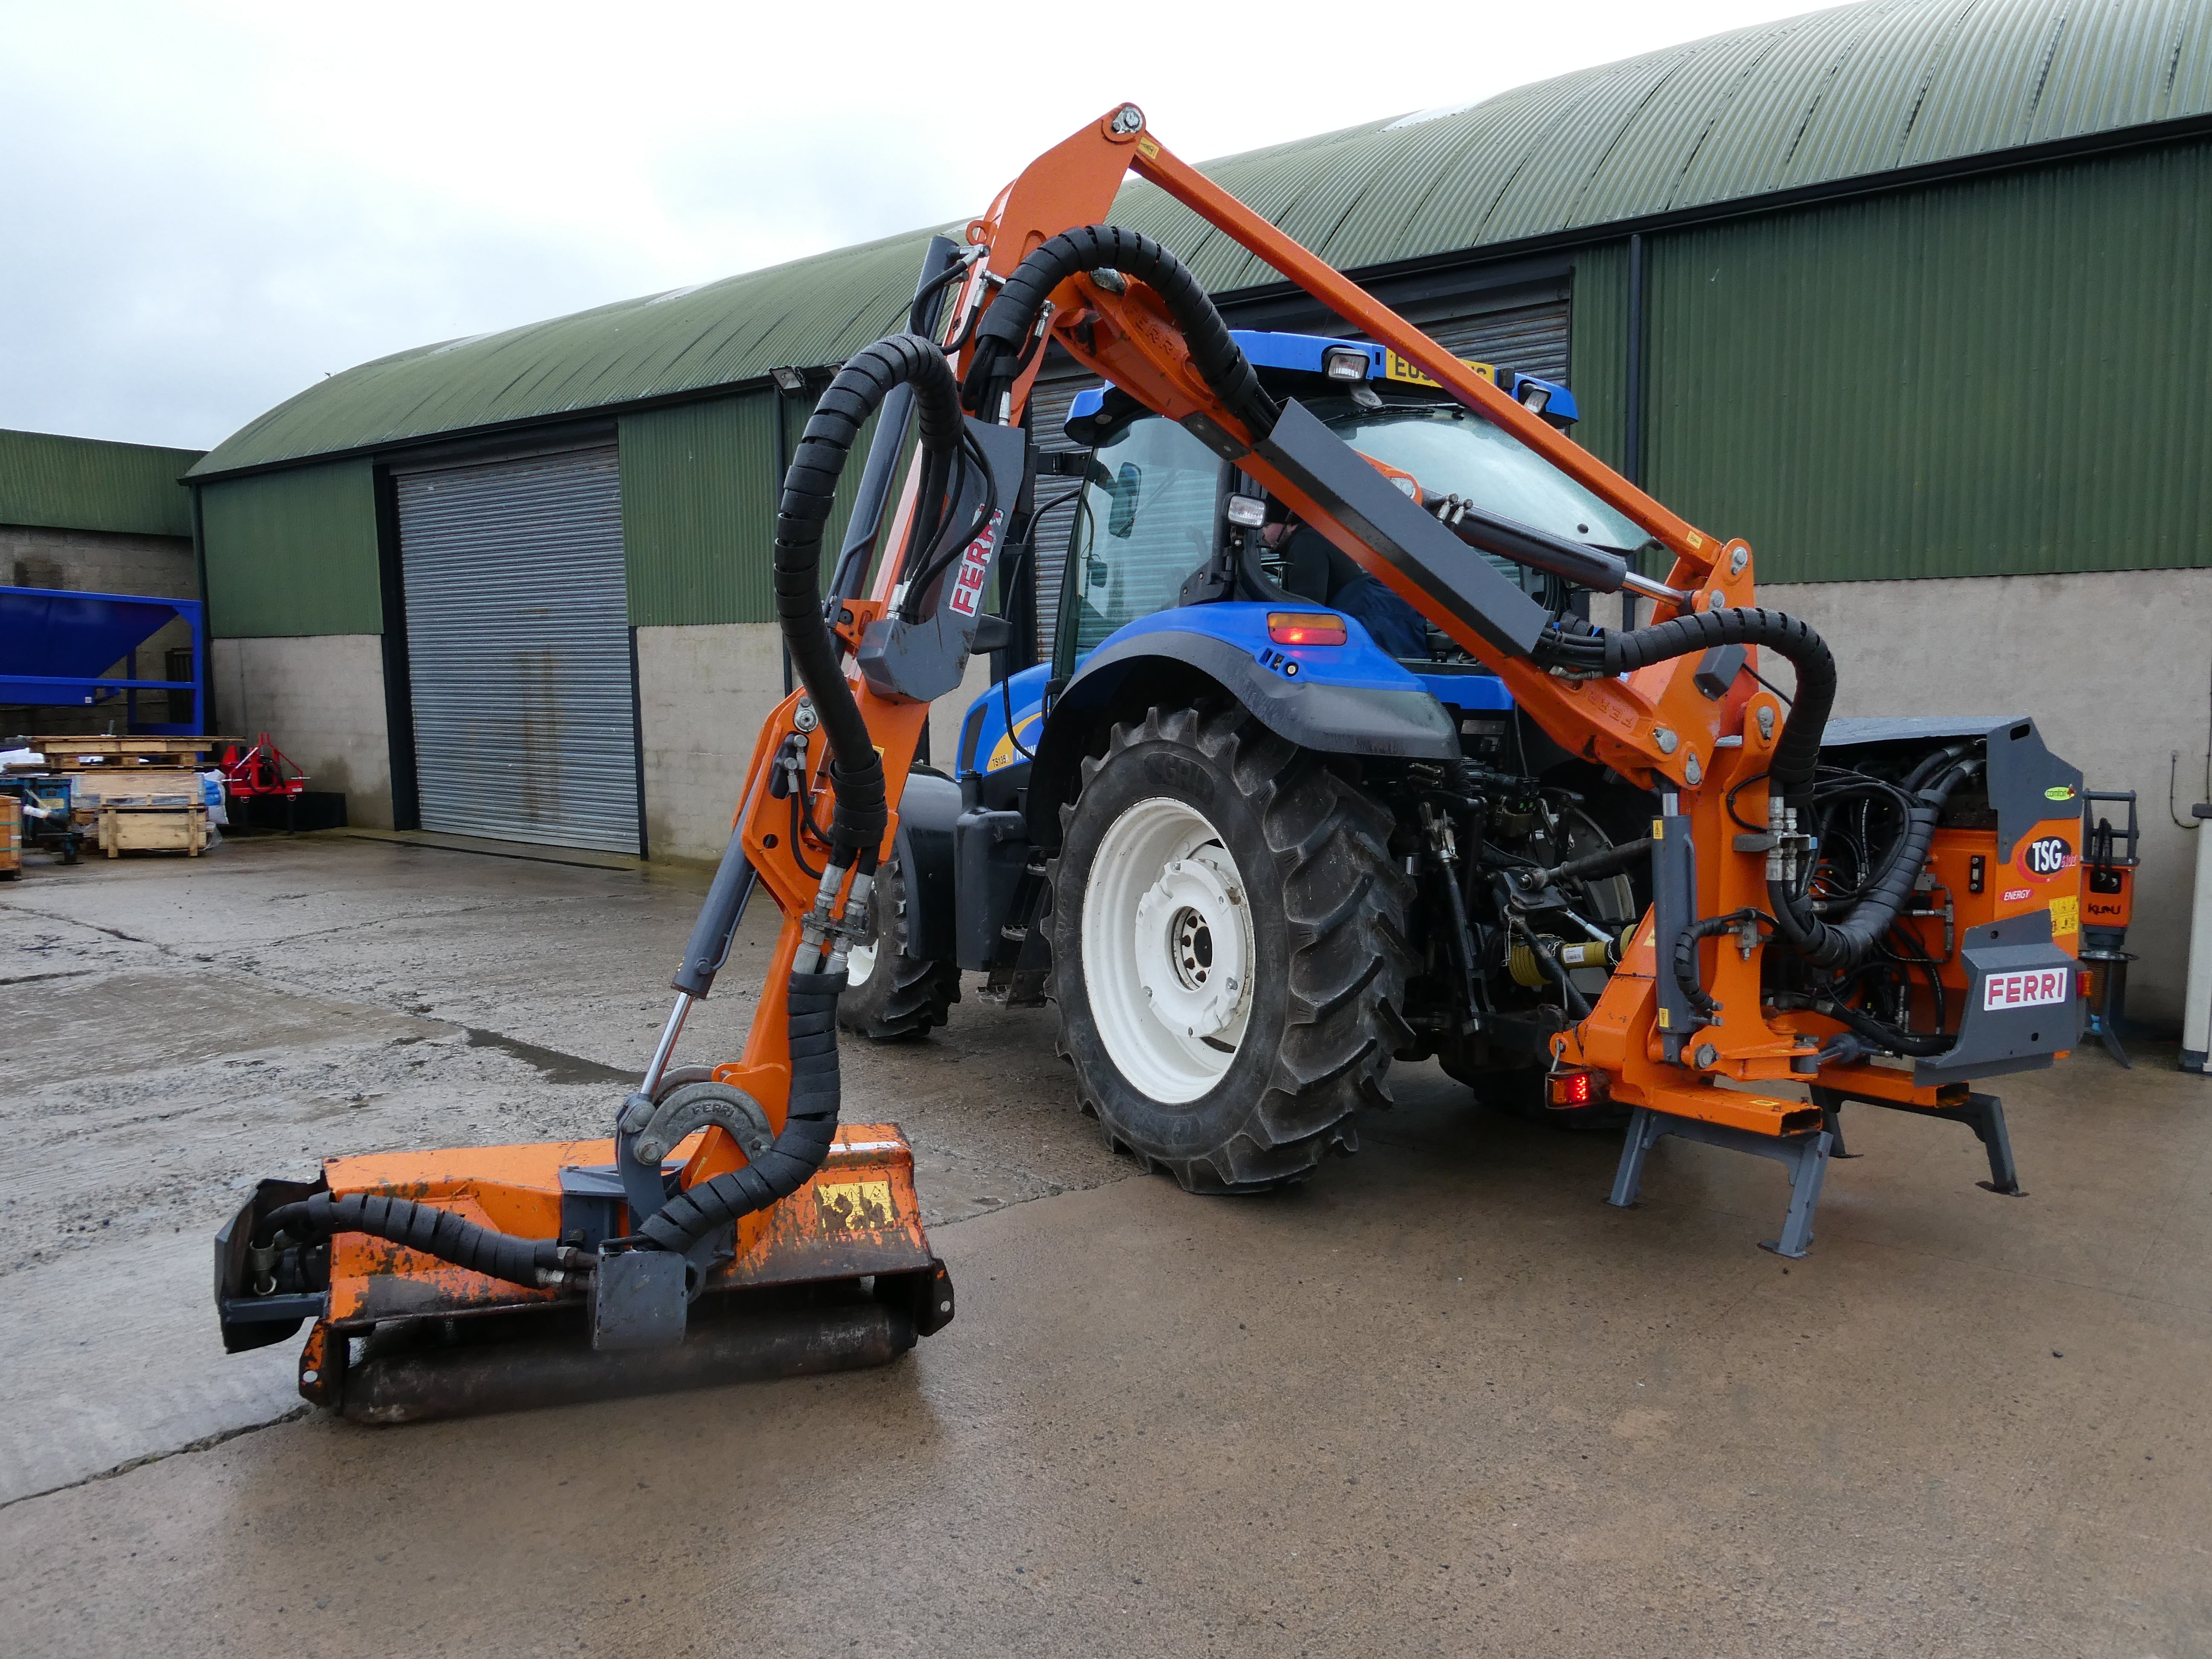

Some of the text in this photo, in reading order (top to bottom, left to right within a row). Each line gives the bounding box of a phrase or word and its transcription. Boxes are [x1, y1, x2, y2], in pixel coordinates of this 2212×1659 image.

[992, 754, 1010, 767] TS135A
[2032, 840, 2062, 871] TSG
[2004, 889, 2031, 901] ENERGY
[1988, 972, 2064, 1005] FERRI
[692, 1102, 735, 1117] FERRI
